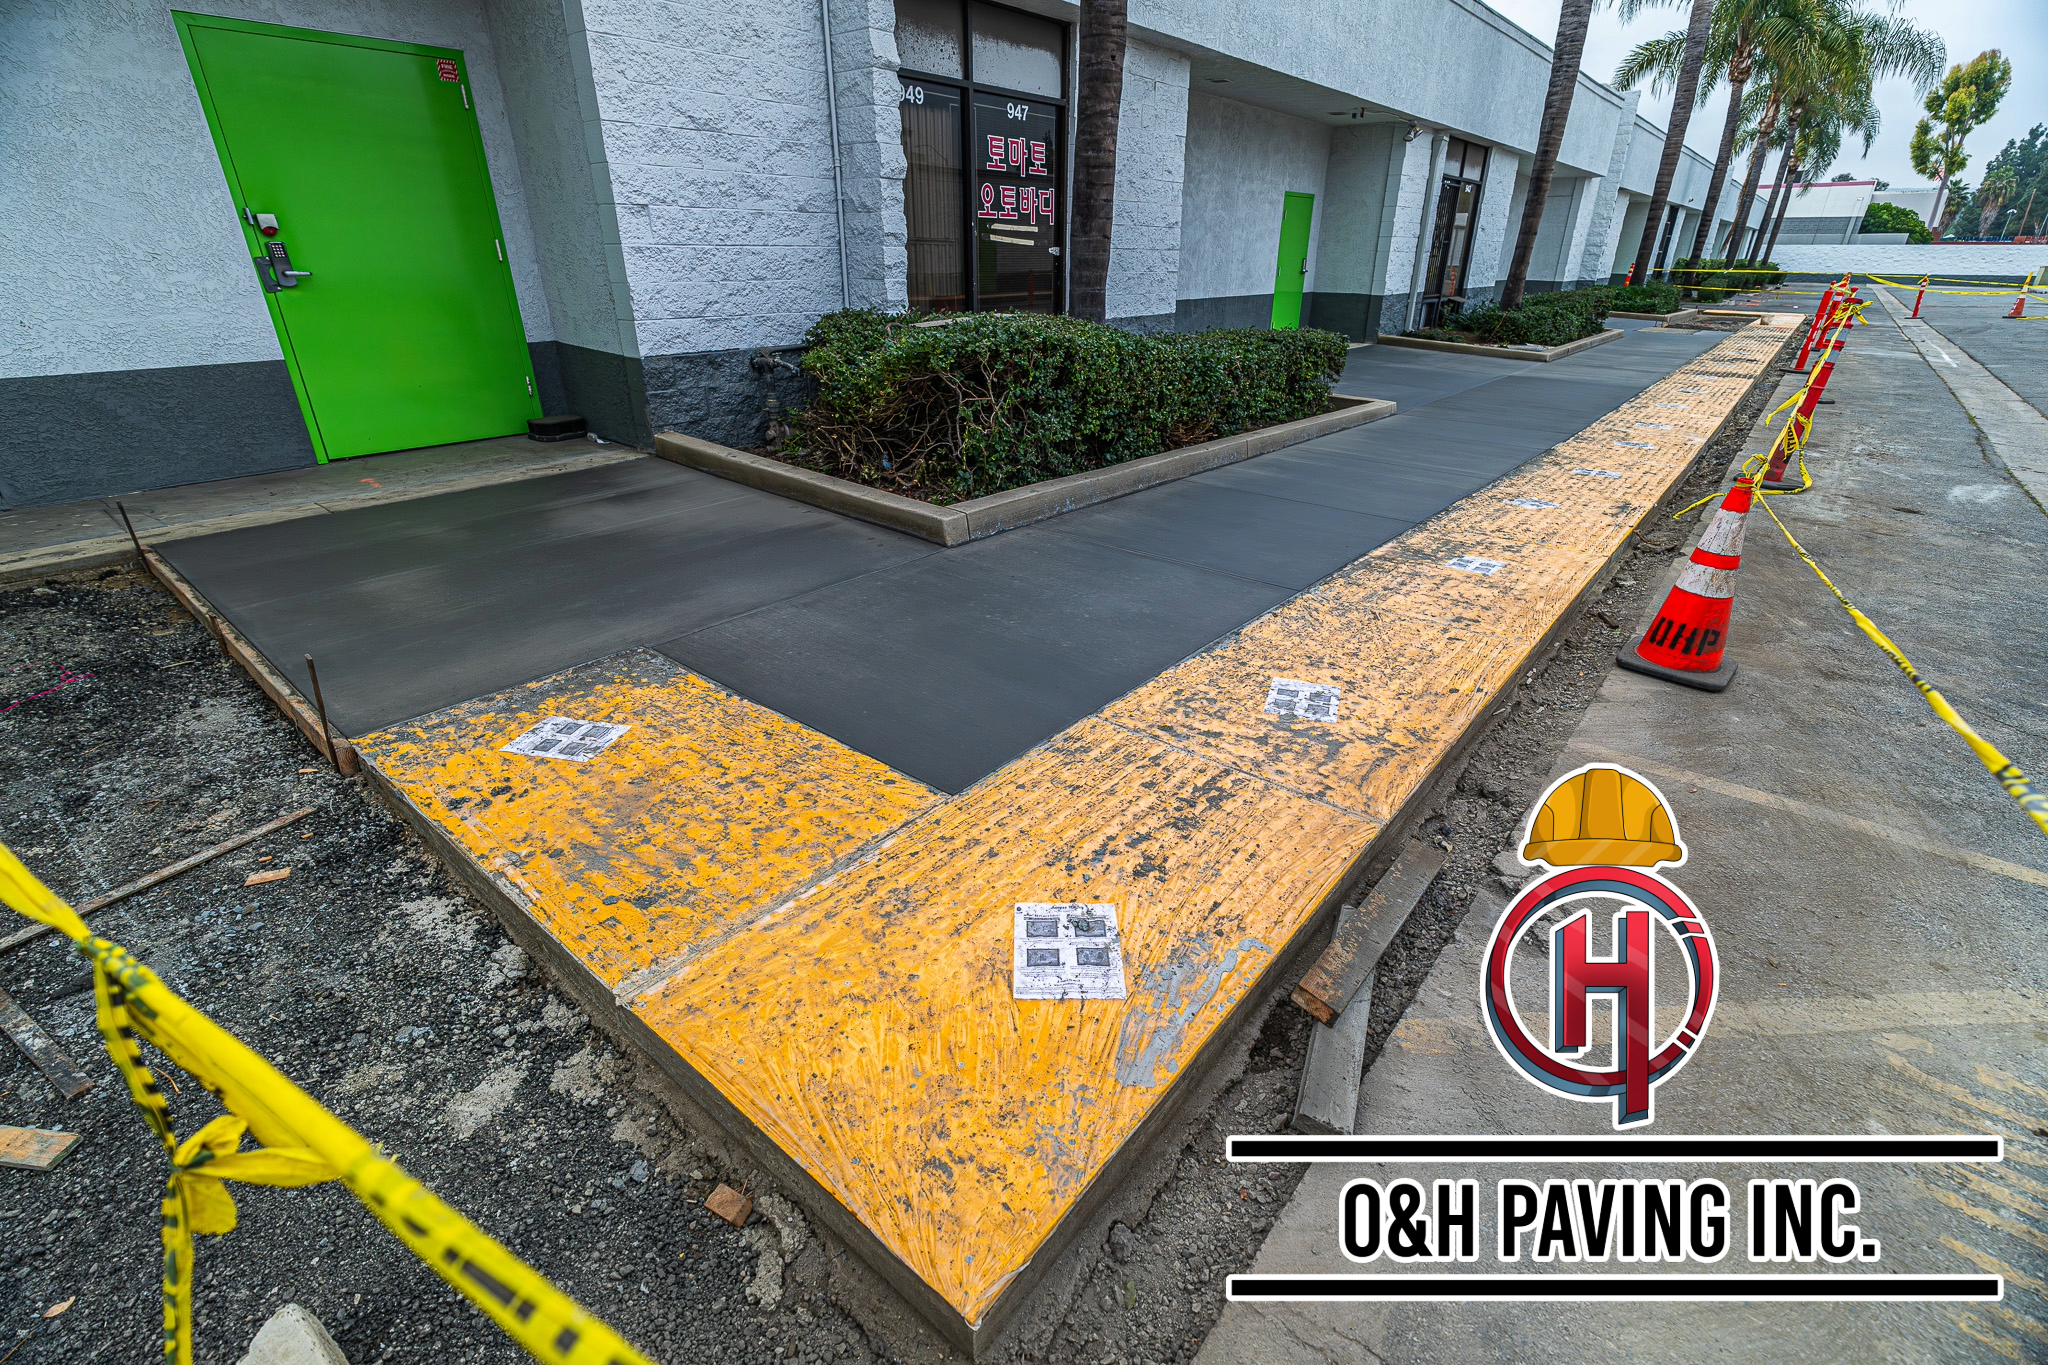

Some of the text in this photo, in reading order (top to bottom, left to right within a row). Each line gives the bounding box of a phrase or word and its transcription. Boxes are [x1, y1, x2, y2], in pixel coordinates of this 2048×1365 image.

[1006, 102, 1029, 121] 947
[986, 134, 1047, 177] 토마토
[978, 182, 1055, 225] 오토바디
